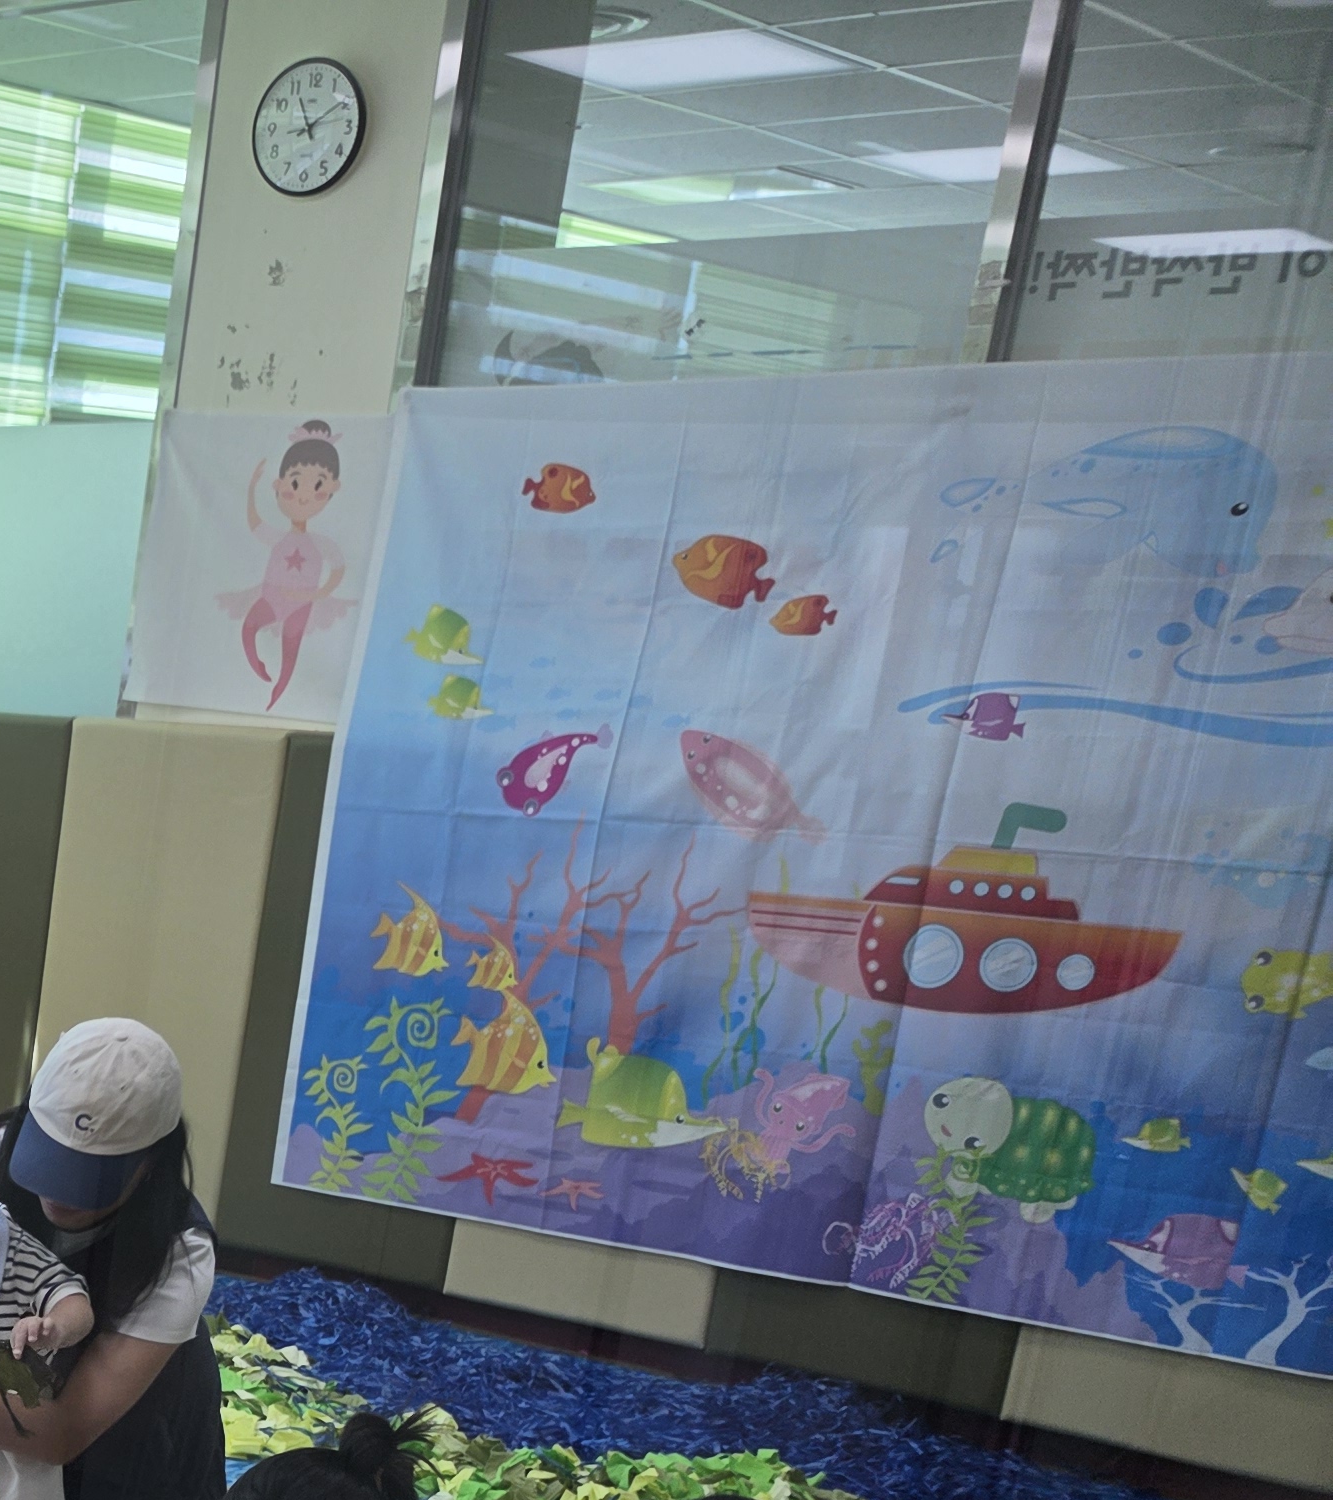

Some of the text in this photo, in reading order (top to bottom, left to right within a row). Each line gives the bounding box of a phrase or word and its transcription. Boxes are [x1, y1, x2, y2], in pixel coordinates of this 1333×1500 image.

[308, 72, 323, 88] 12
[332, 78, 337, 92] 1
[290, 80, 300, 96] 11
[275, 98, 288, 113] 10
[267, 122, 277, 137] 9
[343, 119, 352, 135] 3
[270, 145, 279, 160] 8
[335, 143, 343, 157] 4
[283, 161, 292, 176] 7
[299, 169, 308, 183] 6
[319, 160, 328, 177] 5
